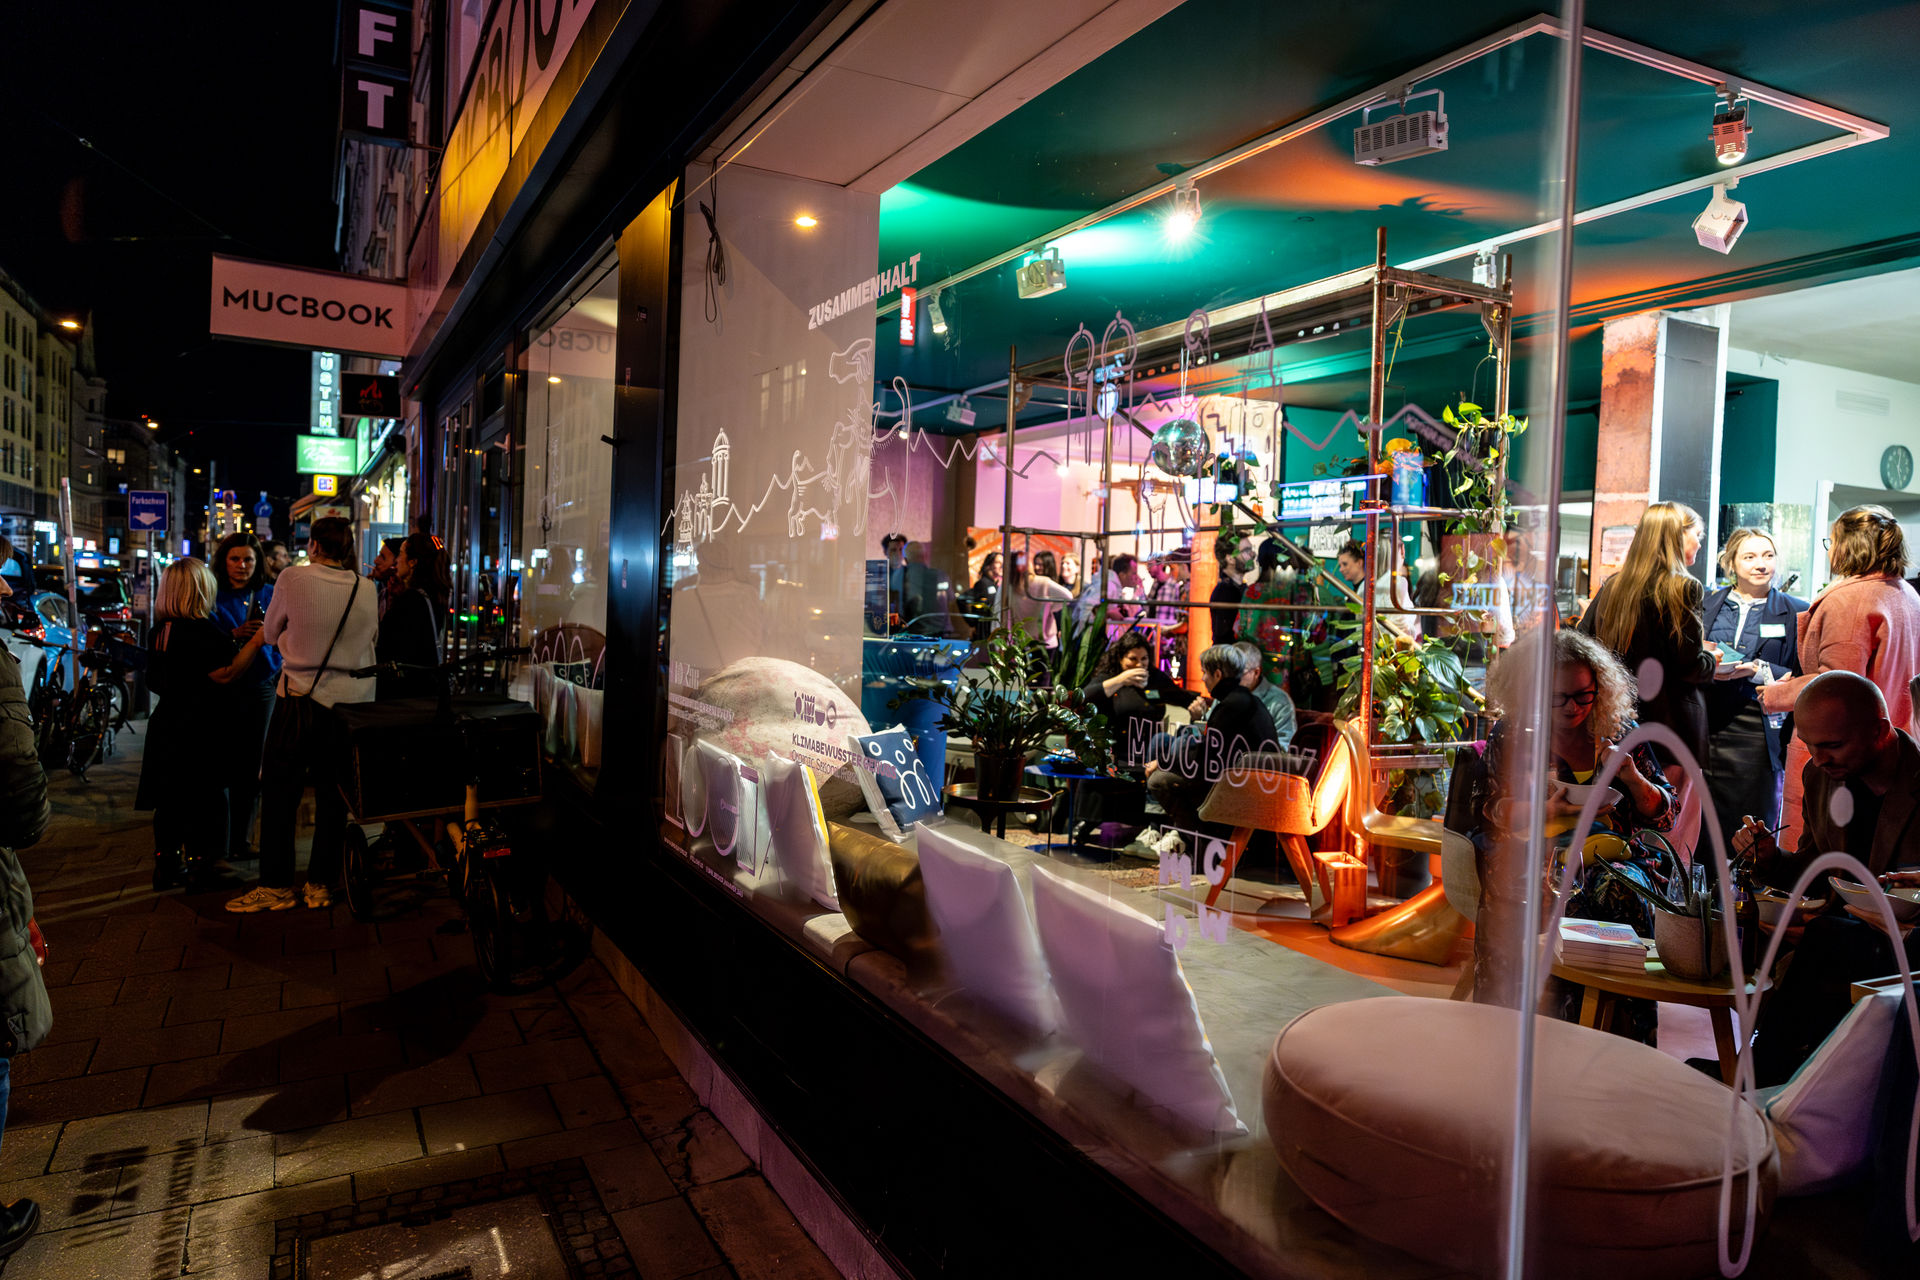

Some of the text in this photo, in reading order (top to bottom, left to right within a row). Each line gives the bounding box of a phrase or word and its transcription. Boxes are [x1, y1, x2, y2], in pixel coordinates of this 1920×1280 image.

[222, 286, 393, 329] MUCBOOK
[808, 252, 921, 330] ZUSAMMENHALT
[319, 352, 334, 428] USTEN
[792, 733, 862, 768] KLIMABEWUSSTER
[1127, 716, 1317, 801] MUCBOOK
